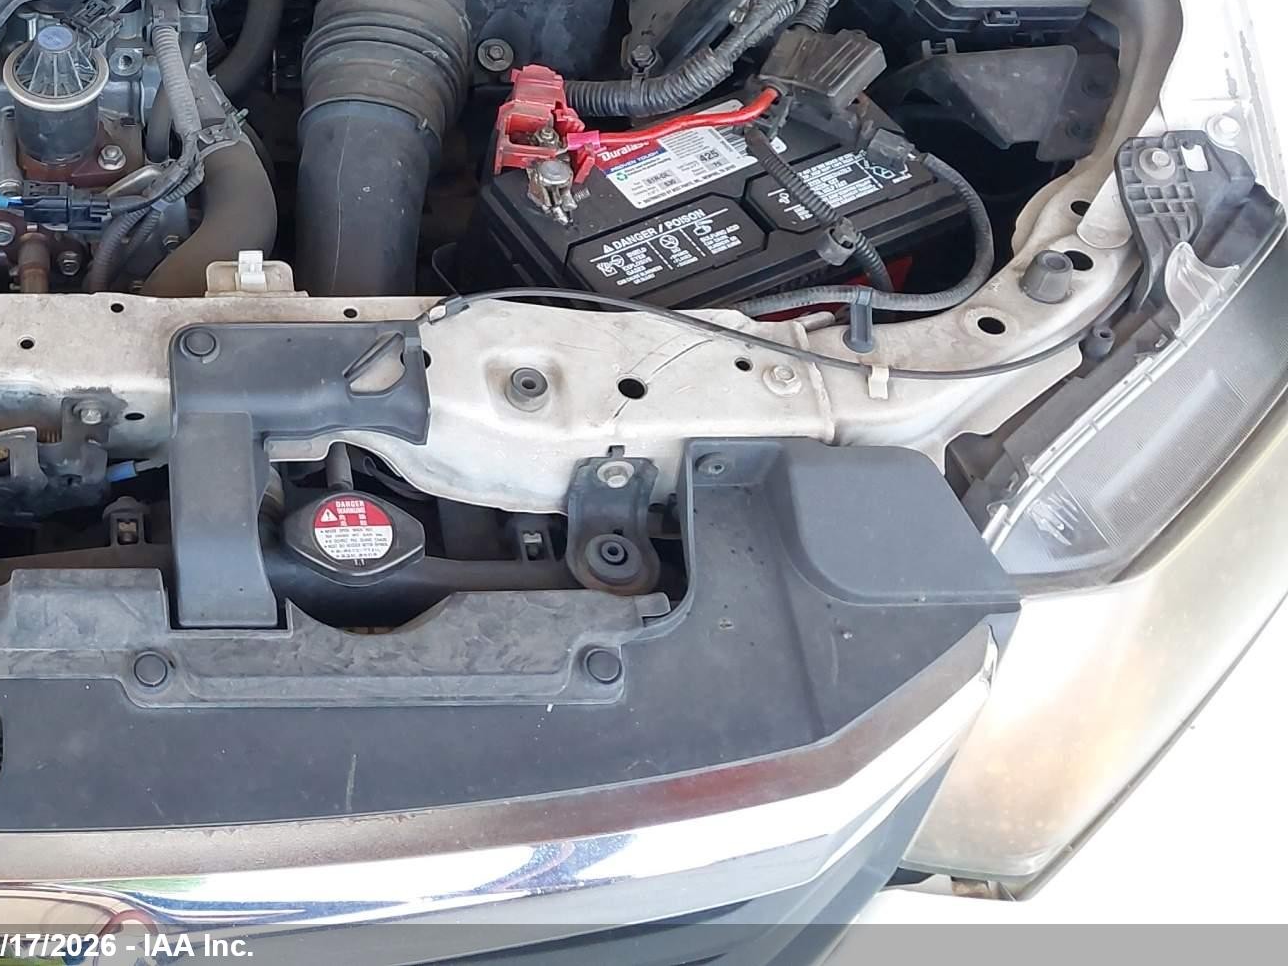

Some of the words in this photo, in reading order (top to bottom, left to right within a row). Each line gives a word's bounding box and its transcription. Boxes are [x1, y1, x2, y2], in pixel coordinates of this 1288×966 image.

[699, 149, 721, 163] 425
[612, 227, 658, 250] DANGER
[664, 208, 706, 230] POISON
[630, 253, 647, 263] EYES
[336, 500, 365, 508] DANGER
